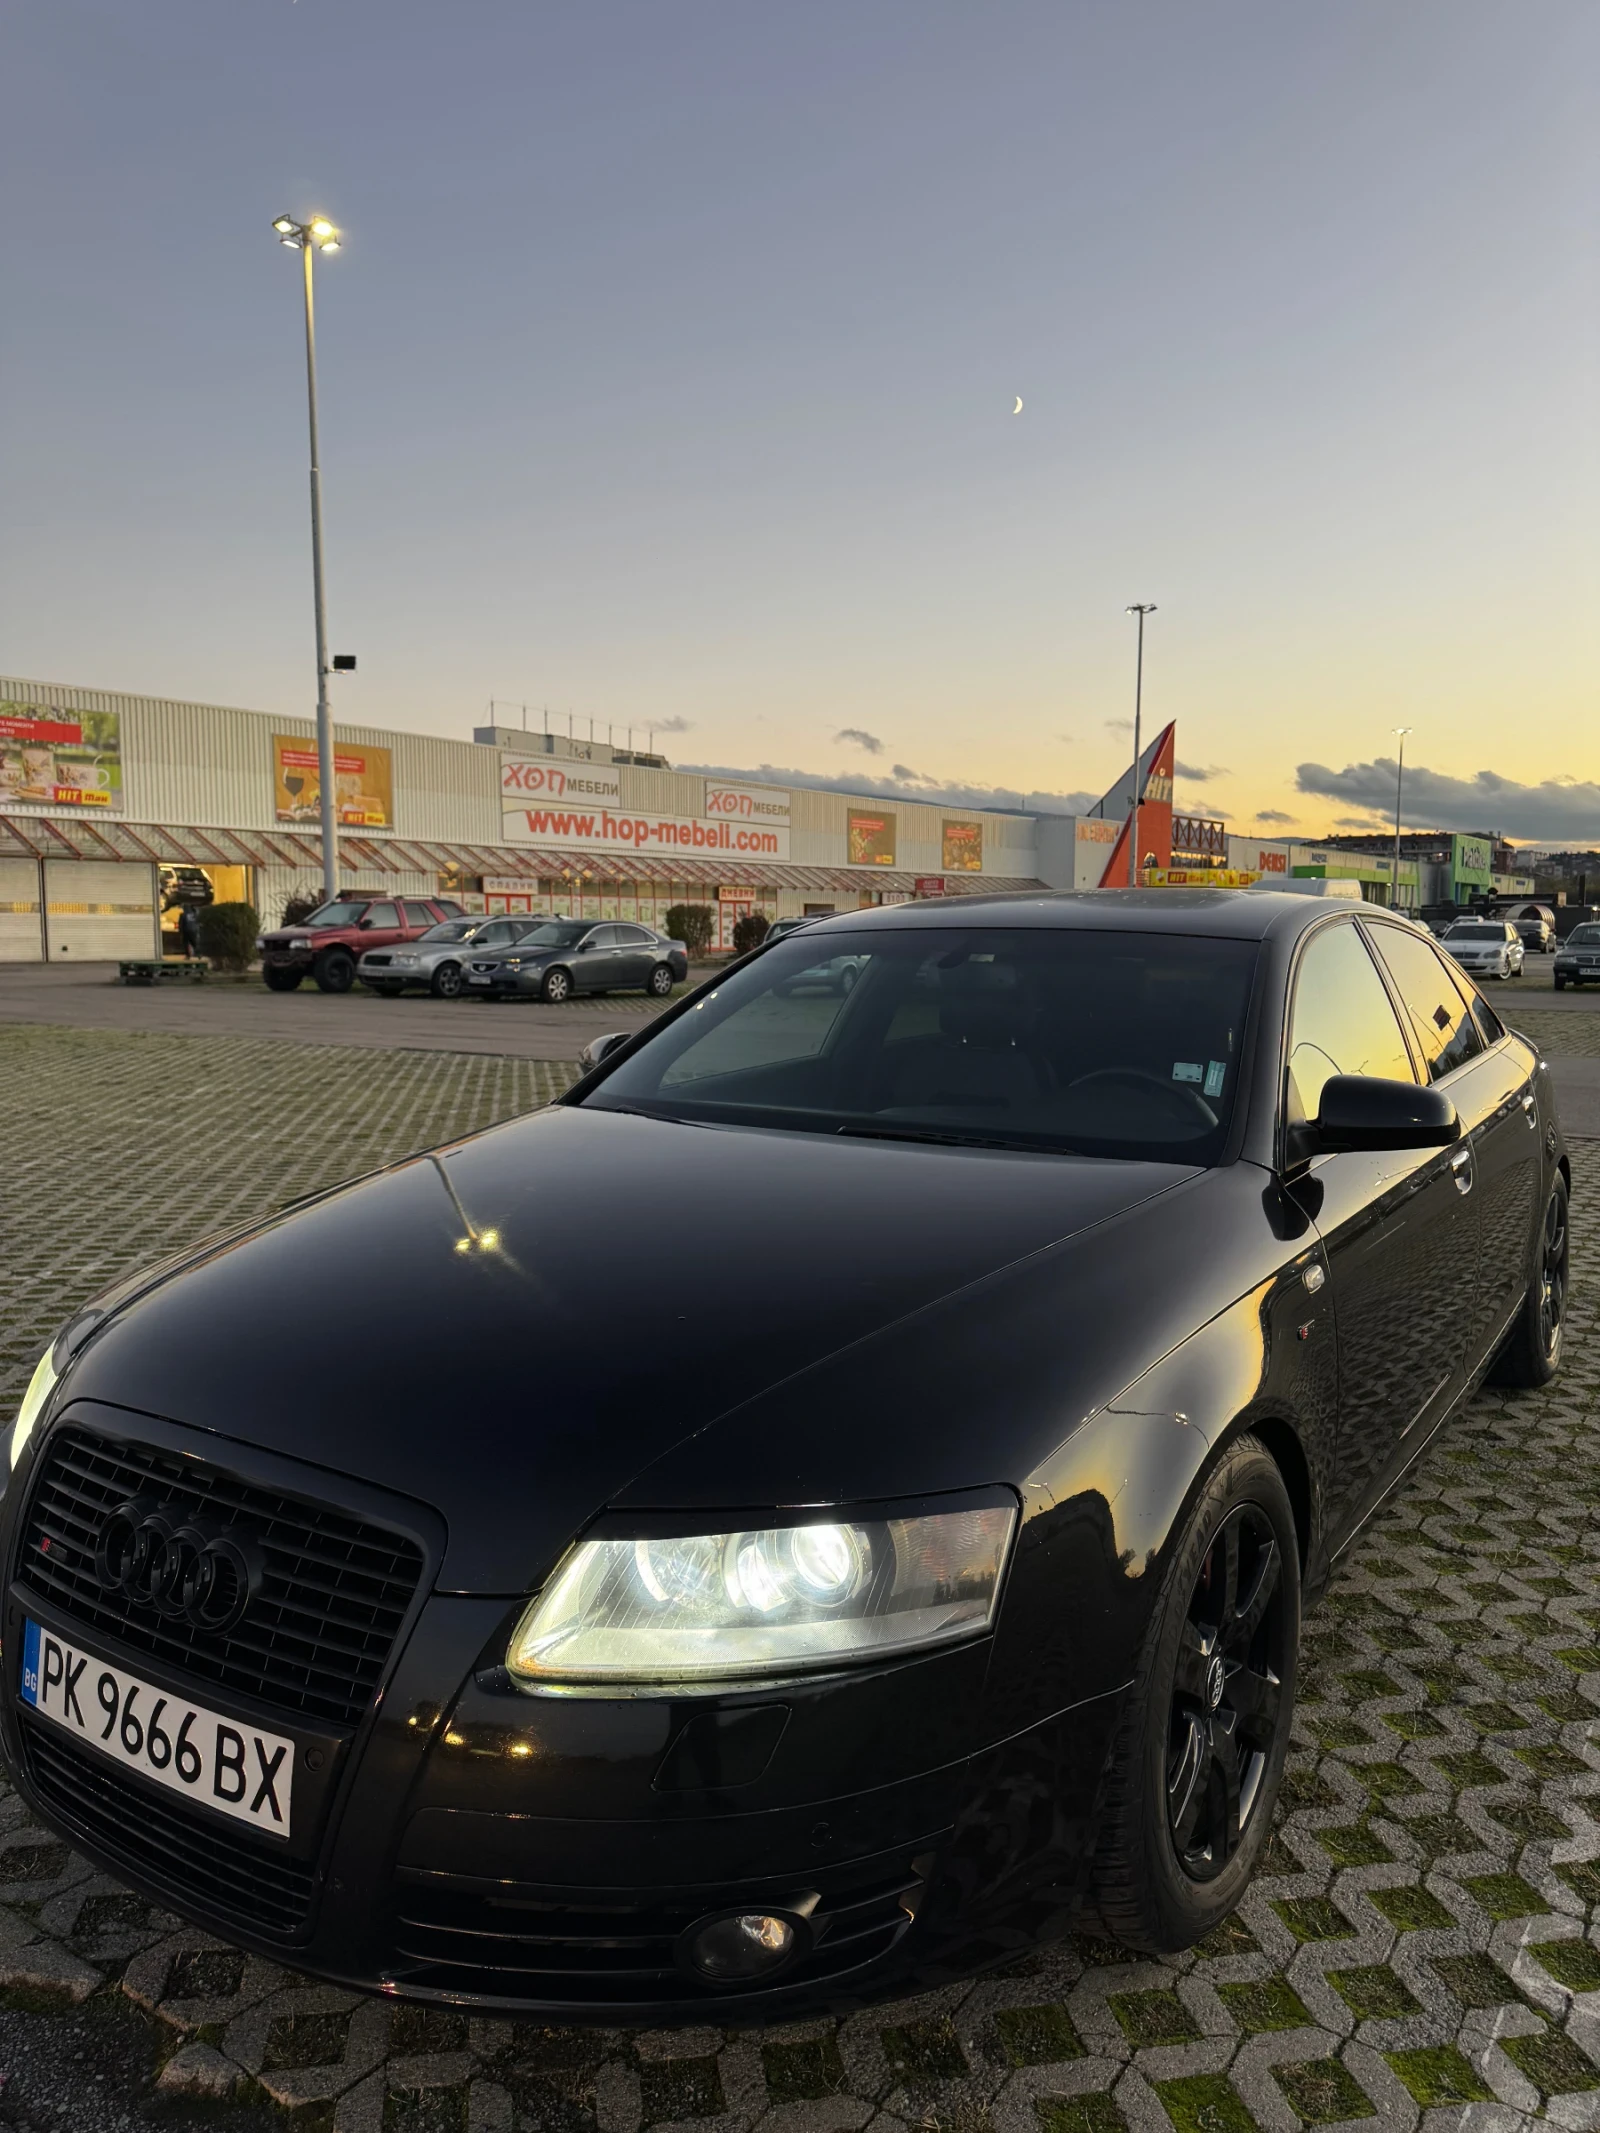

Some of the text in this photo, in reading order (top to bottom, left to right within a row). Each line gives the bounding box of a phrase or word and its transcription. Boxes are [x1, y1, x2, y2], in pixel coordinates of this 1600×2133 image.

[58, 790, 80, 801] HIT
[567, 778, 619, 796] МЕБЕЛИ
[1146, 777, 1170, 801] HIT
[753, 802, 790, 816] МЕБЕЛИ
[525, 809, 778, 853] www.hop-mebeli.com
[1170, 872, 1185, 882] HIT
[722, 888, 755, 898] ДНЕВНИ
[24, 1667, 37, 1692] BG
[42, 1637, 287, 1823] PK 9666 BX
